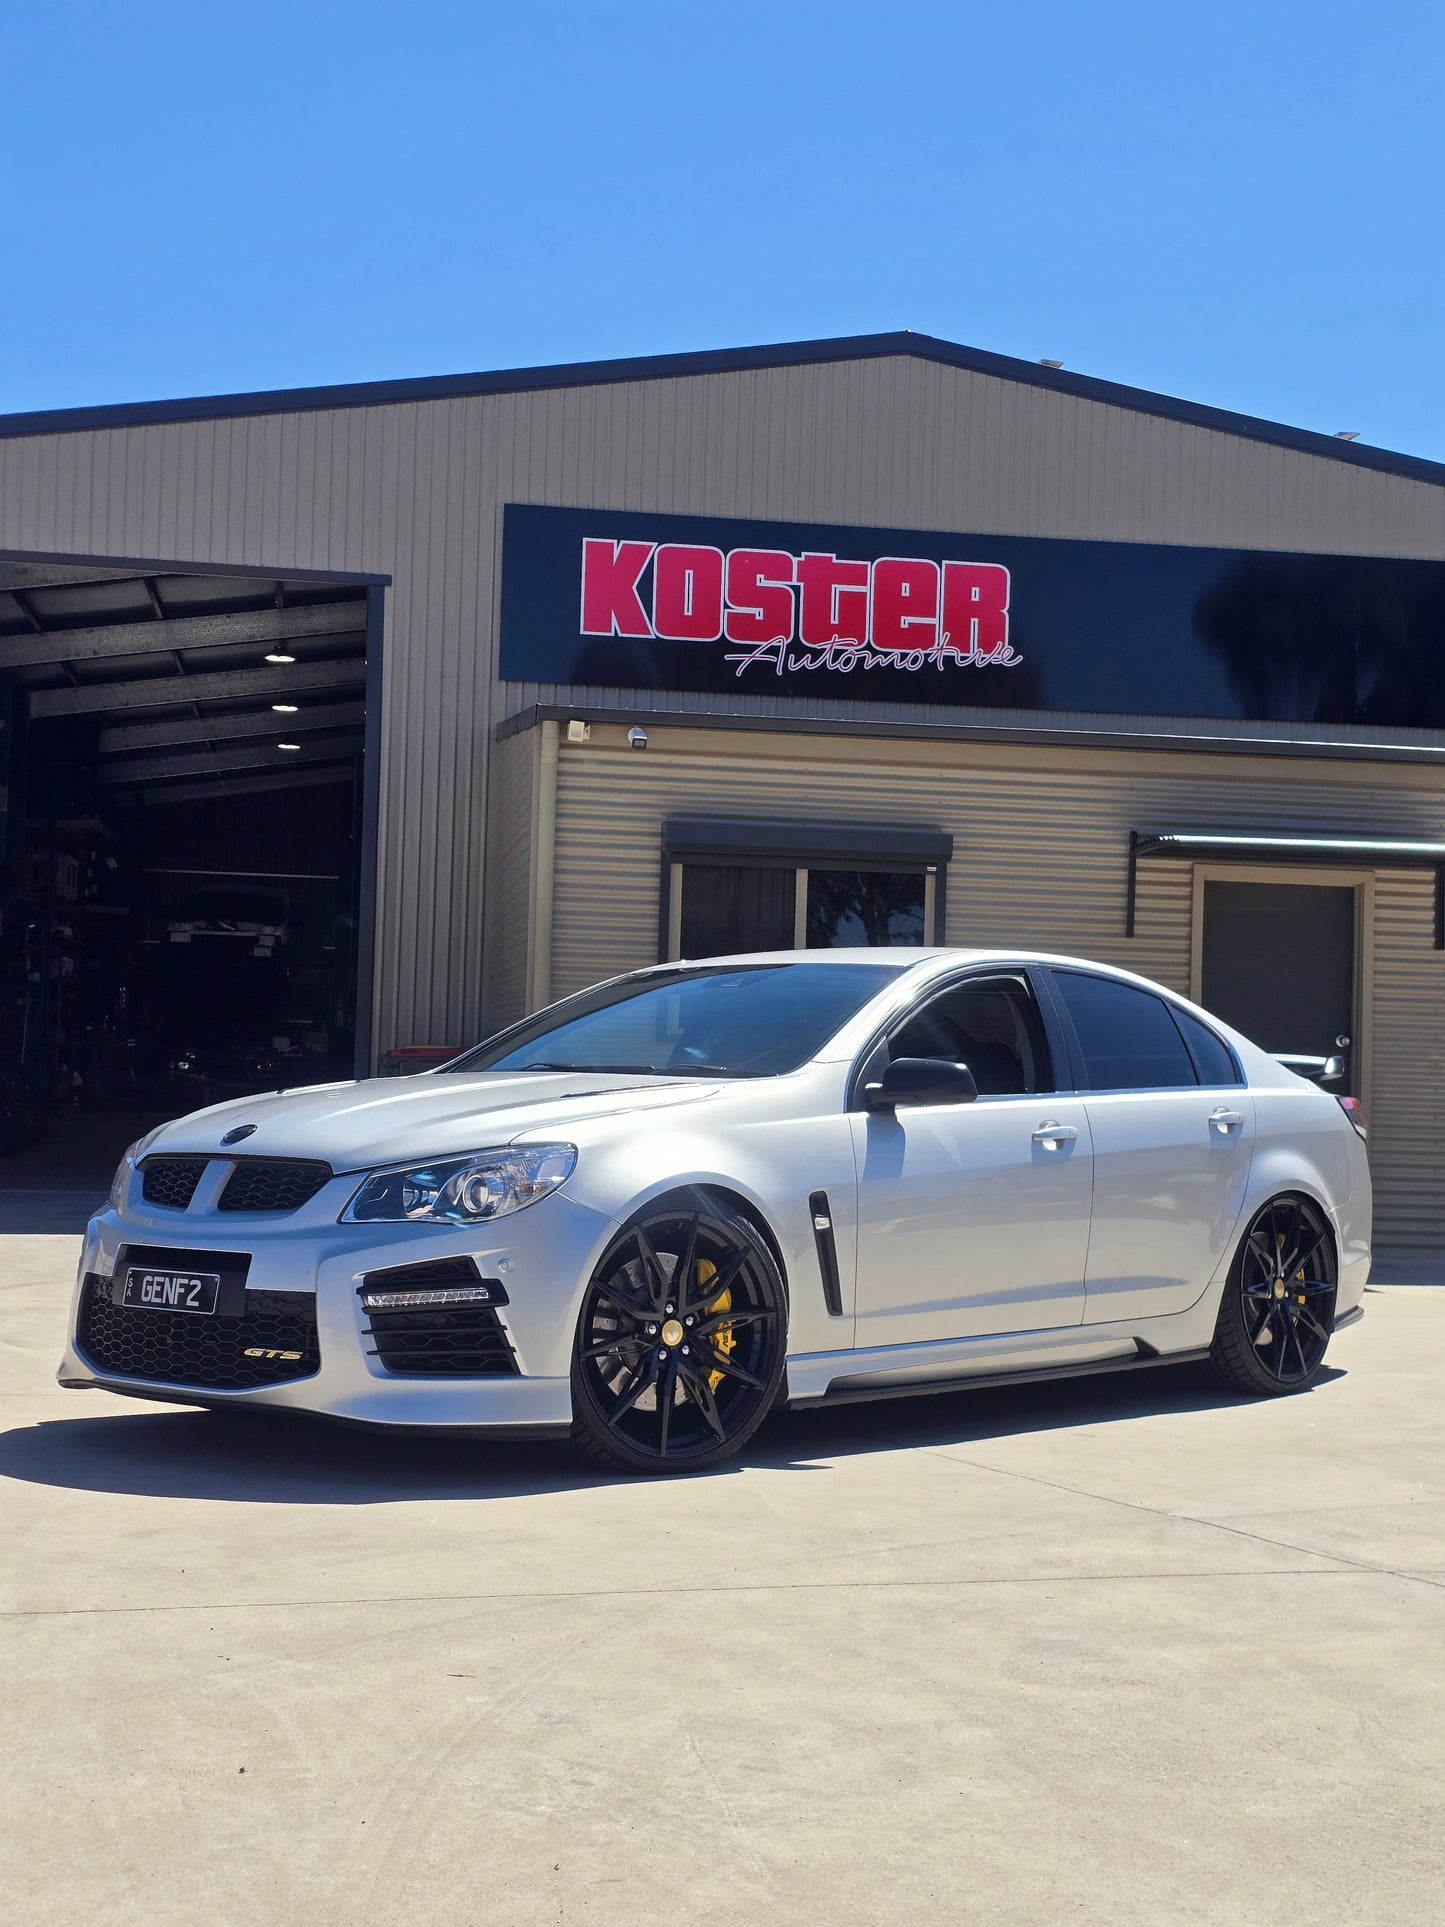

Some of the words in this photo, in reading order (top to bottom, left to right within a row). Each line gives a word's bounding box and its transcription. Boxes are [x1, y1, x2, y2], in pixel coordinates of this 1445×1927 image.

[725, 632, 1023, 676] Automotive
[126, 1277, 133, 1297] SA
[141, 1275, 202, 1307] GENF2
[243, 1347, 304, 1360] GTS
